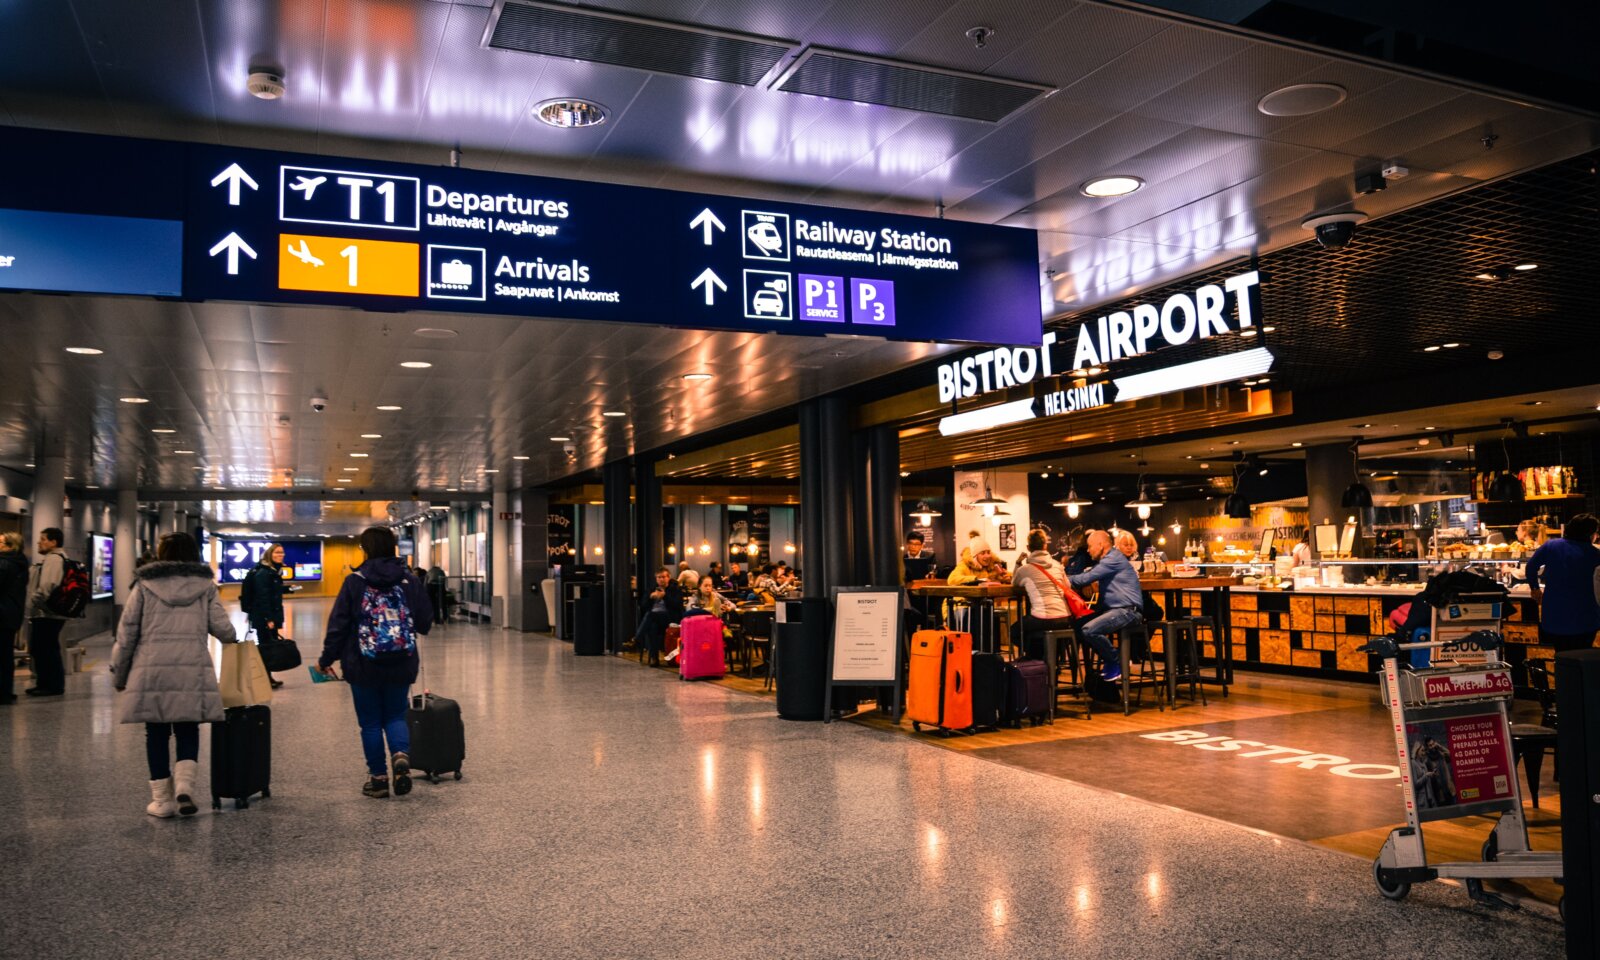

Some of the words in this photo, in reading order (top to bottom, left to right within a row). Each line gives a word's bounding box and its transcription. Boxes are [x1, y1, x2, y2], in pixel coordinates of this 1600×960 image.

[338, 177, 395, 223] T1
[427, 185, 569, 218] Departures
[427, 213, 486, 230] Lähtevät
[495, 218, 559, 237] Avgångar
[795, 219, 877, 251] Railway
[880, 228, 952, 254] Station
[340, 245, 358, 287] 1
[494, 255, 591, 283] Arrivals
[796, 245, 875, 264] Rautatieasema
[881, 252, 959, 271] Järnvägsstation
[494, 283, 554, 299] Saapuvat
[563, 287, 620, 303] Ankomst
[806, 308, 839, 319] SERVICE
[937, 331, 1057, 404] BISTROT
[1072, 270, 1260, 371] AIRPORT
[1044, 383, 1105, 417] HELSINKI
[1428, 681, 1452, 694] DNA
[1495, 677, 1510, 688] 4G
[1450, 723, 1476, 733] CHOOSE
[1451, 733, 1467, 741] OWN
[1482, 729, 1494, 737] FOR
[1138, 729, 1402, 780] BISTRO
[1452, 740, 1478, 750] PREPAID
